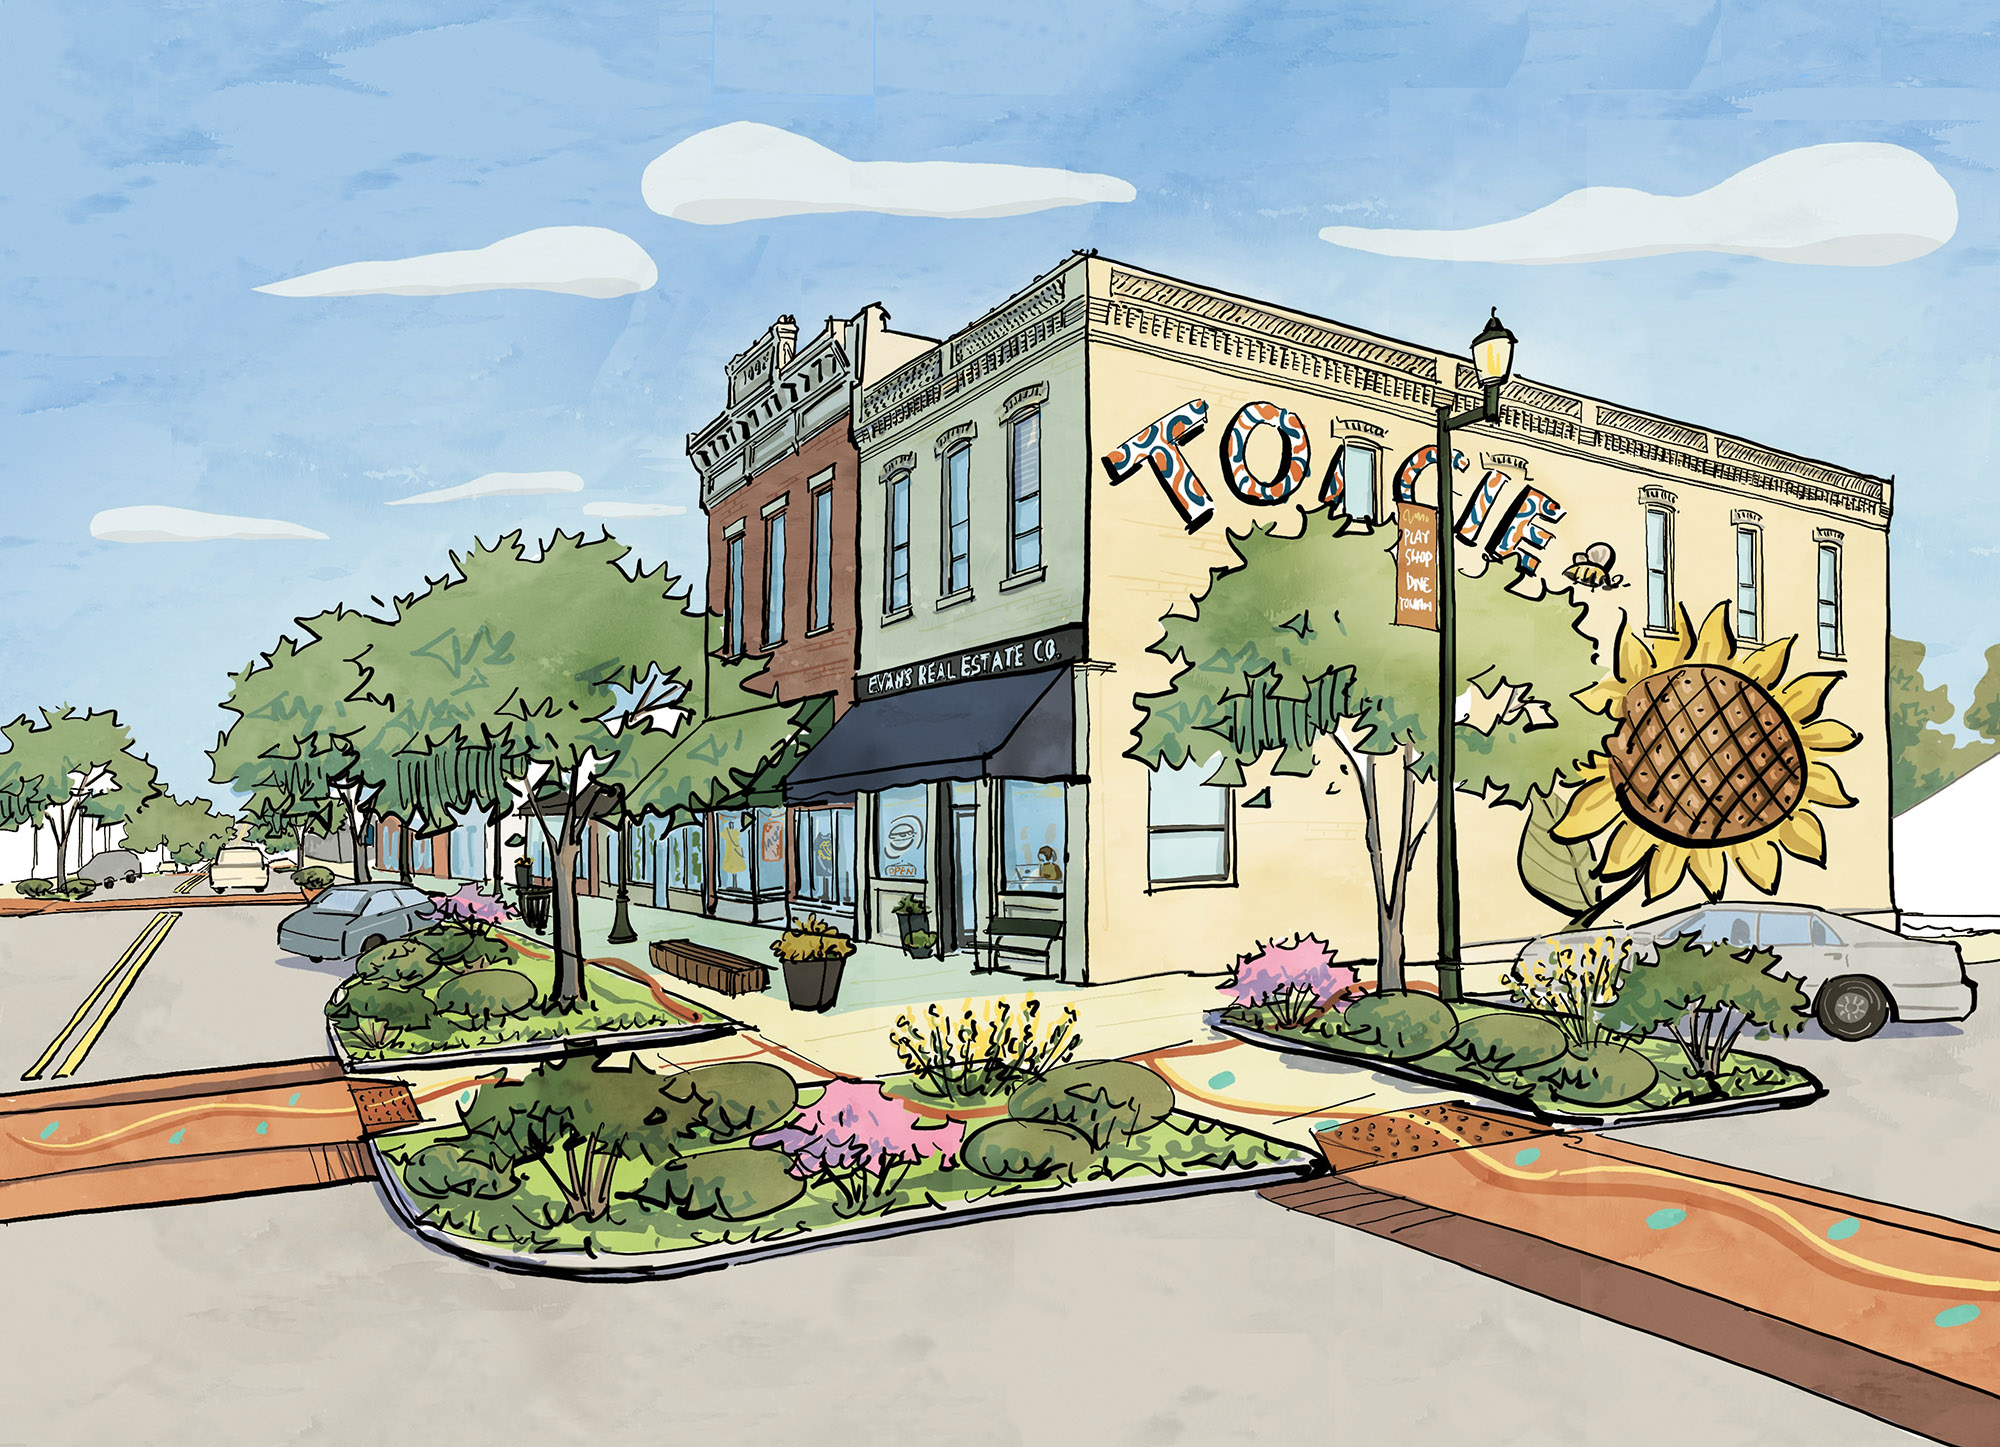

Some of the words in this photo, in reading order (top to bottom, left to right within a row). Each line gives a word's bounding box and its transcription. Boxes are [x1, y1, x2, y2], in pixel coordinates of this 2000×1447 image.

[1404, 527, 1430, 546] PLAY
[1405, 548, 1433, 568] SHOP
[918, 660, 956, 686] REAL
[960, 643, 1024, 677] ESTATE
[1033, 638, 1061, 662] CO.
[888, 866, 914, 876] OPEN
